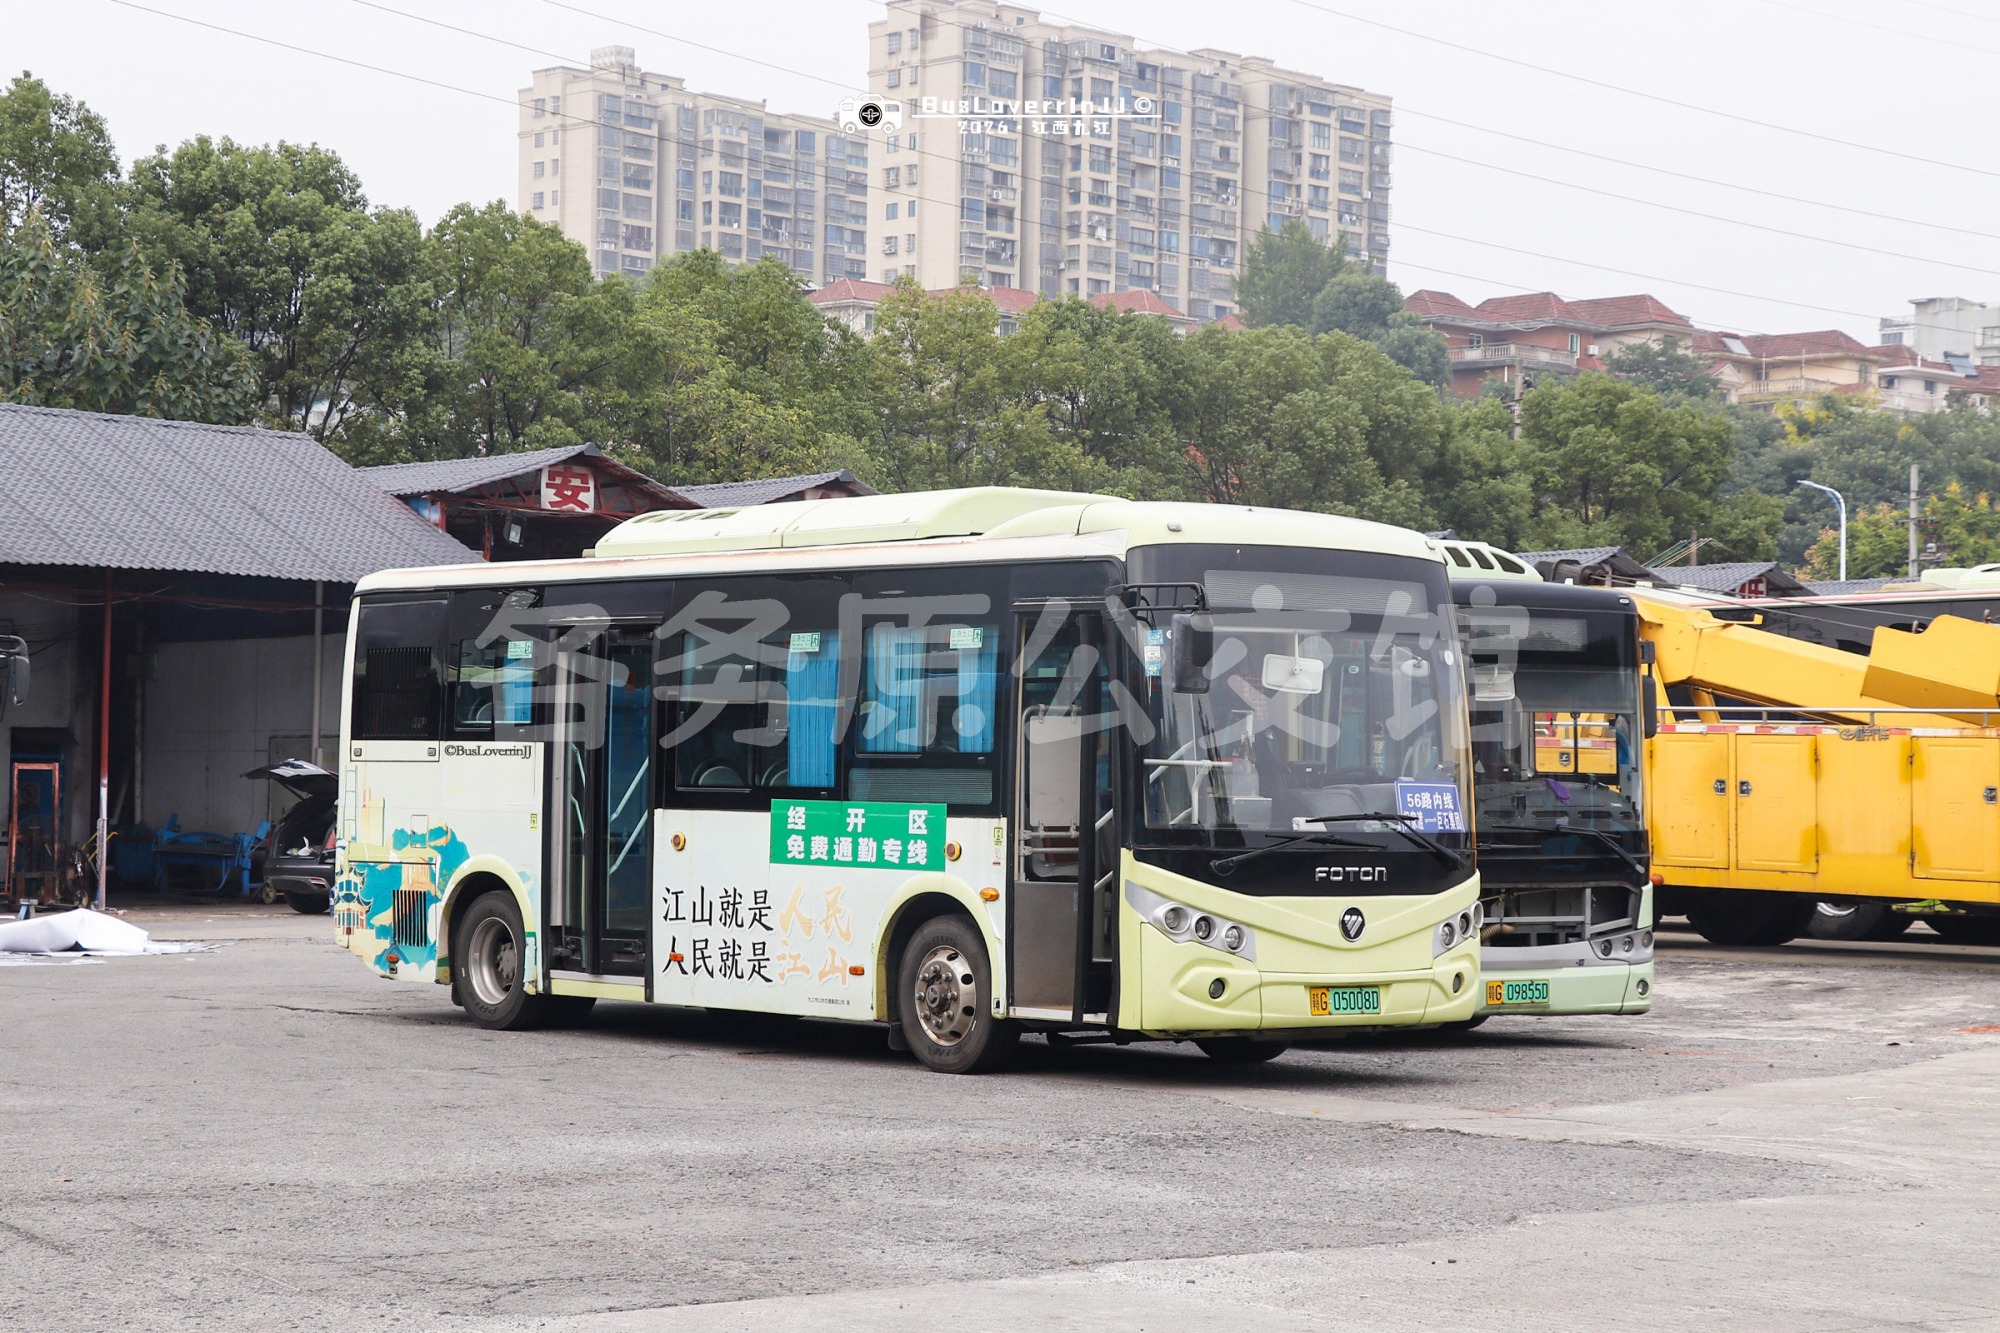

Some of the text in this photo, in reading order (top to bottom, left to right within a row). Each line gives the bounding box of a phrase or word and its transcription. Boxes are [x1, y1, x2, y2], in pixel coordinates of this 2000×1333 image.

[546, 466, 591, 511] 安
[1406, 792, 1455, 810] 56路内线
[786, 834, 928, 866] 免费通勤专线
[1315, 866, 1388, 882] FOTON
